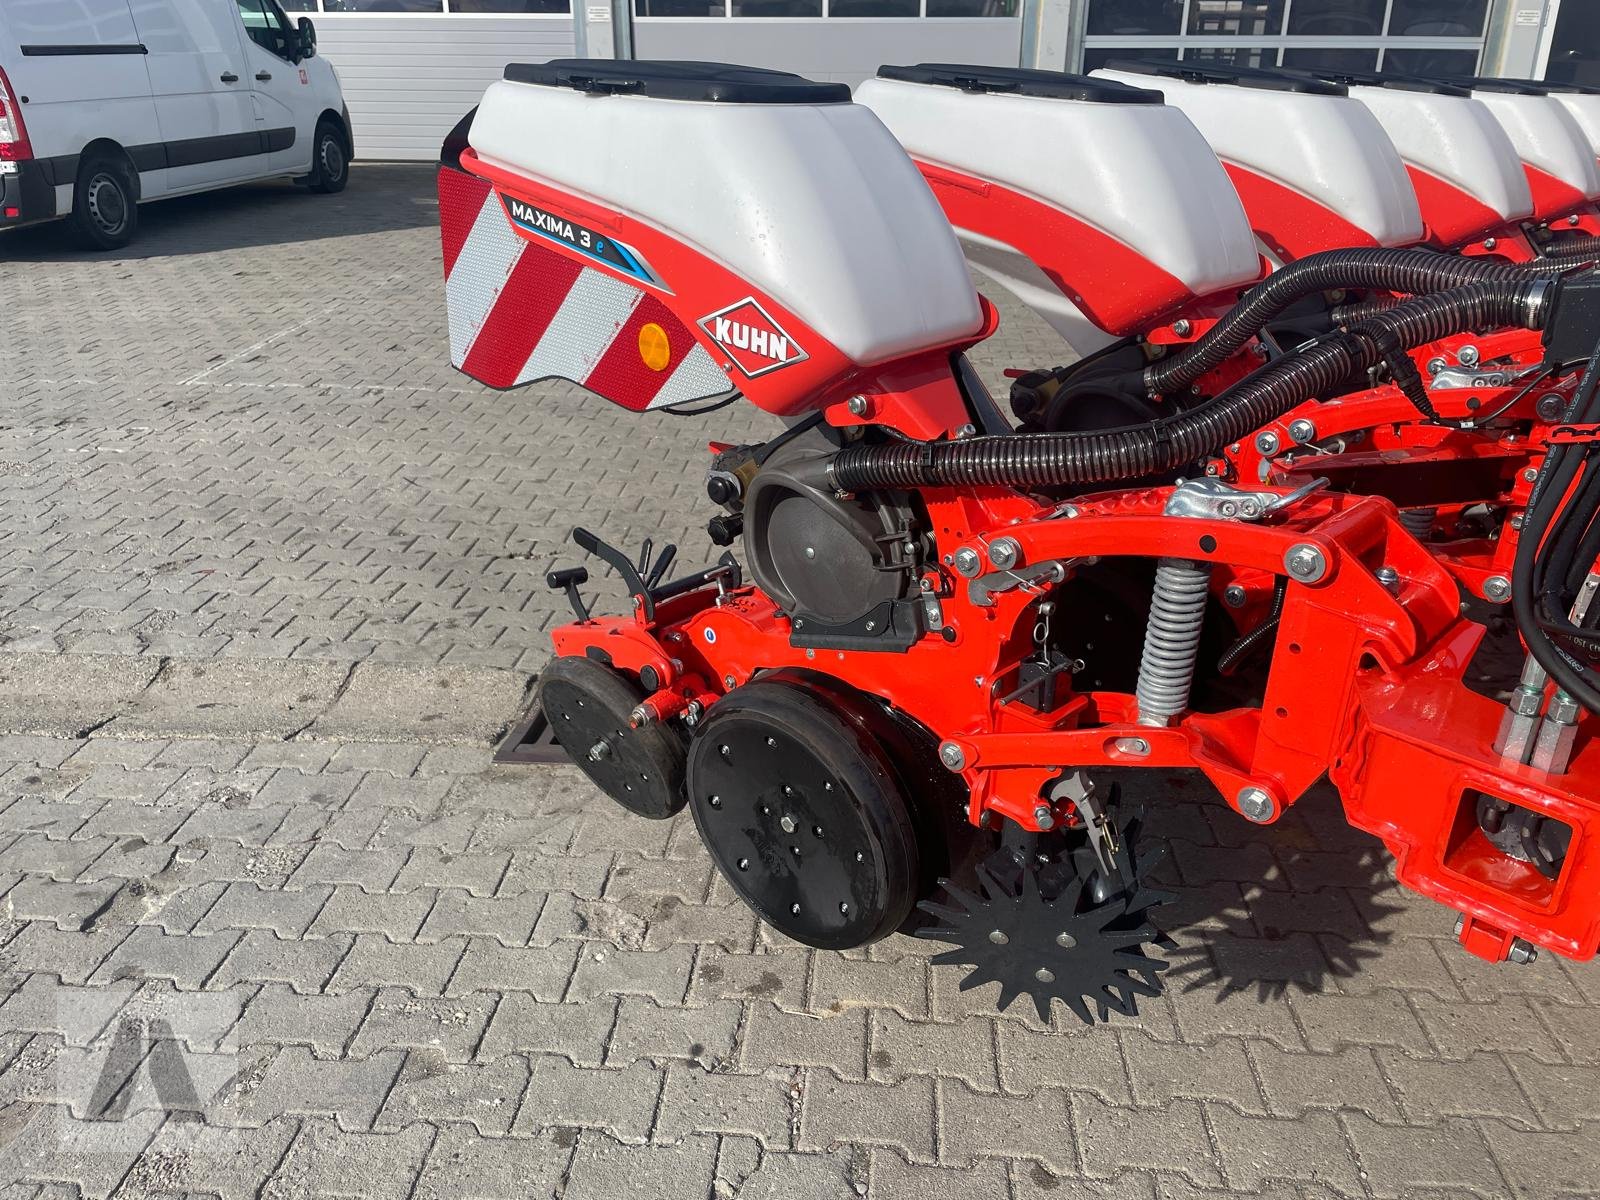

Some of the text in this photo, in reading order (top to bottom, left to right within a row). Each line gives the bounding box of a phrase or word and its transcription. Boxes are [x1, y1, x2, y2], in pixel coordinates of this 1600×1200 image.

[512, 201, 605, 253] MAXIMA 3 e
[715, 316, 787, 362] KUHN
